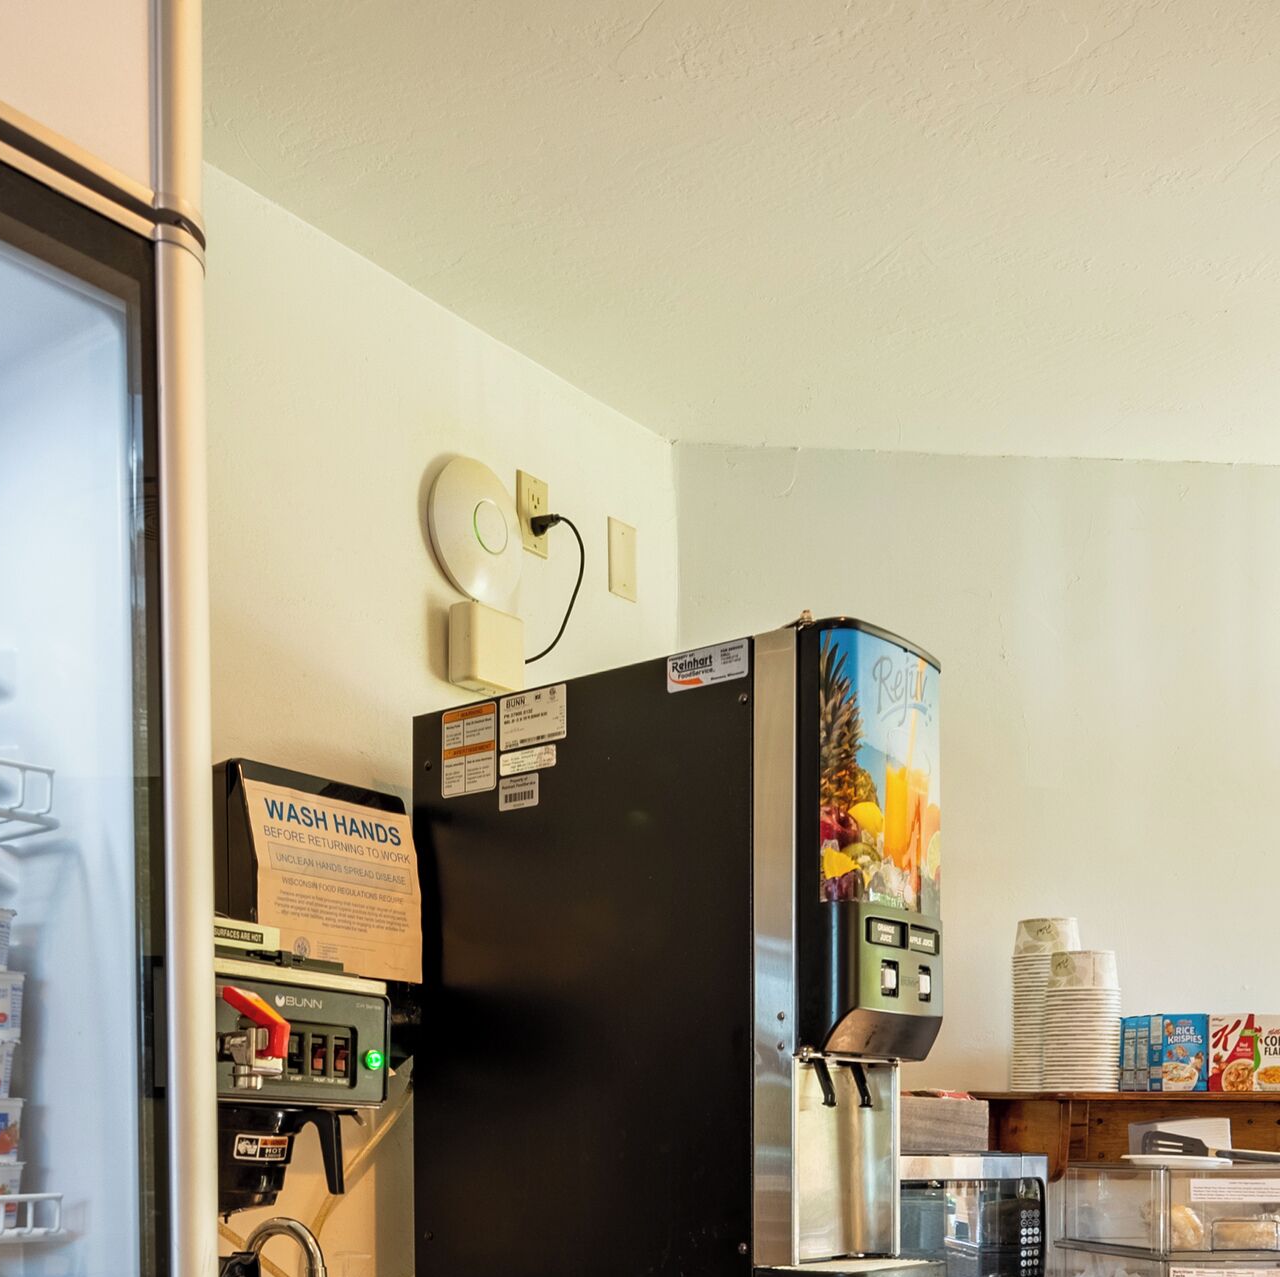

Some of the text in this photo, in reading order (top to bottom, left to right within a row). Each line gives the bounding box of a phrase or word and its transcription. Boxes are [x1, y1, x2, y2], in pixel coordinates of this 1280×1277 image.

[672, 654, 712, 673] Reinhart
[505, 697, 526, 709] BUNN
[264, 797, 402, 847] WASH HANDS
[263, 825, 411, 865] BEFORE RETURNING TO WORK
[276, 853, 407, 886] UNCLEAN HANDS SPREAD DISEASE
[281, 876, 319, 891] WISCONSIN
[319, 882, 337, 895] FOOD
[336, 885, 378, 902] REGULATIONS
[241, 931, 251, 941] ARE
[251, 932, 263, 943] HOT
[285, 996, 323, 1010] BUNN
[1175, 1026, 1196, 1036] RICE
[1167, 1033, 1203, 1046] KRISPIES
